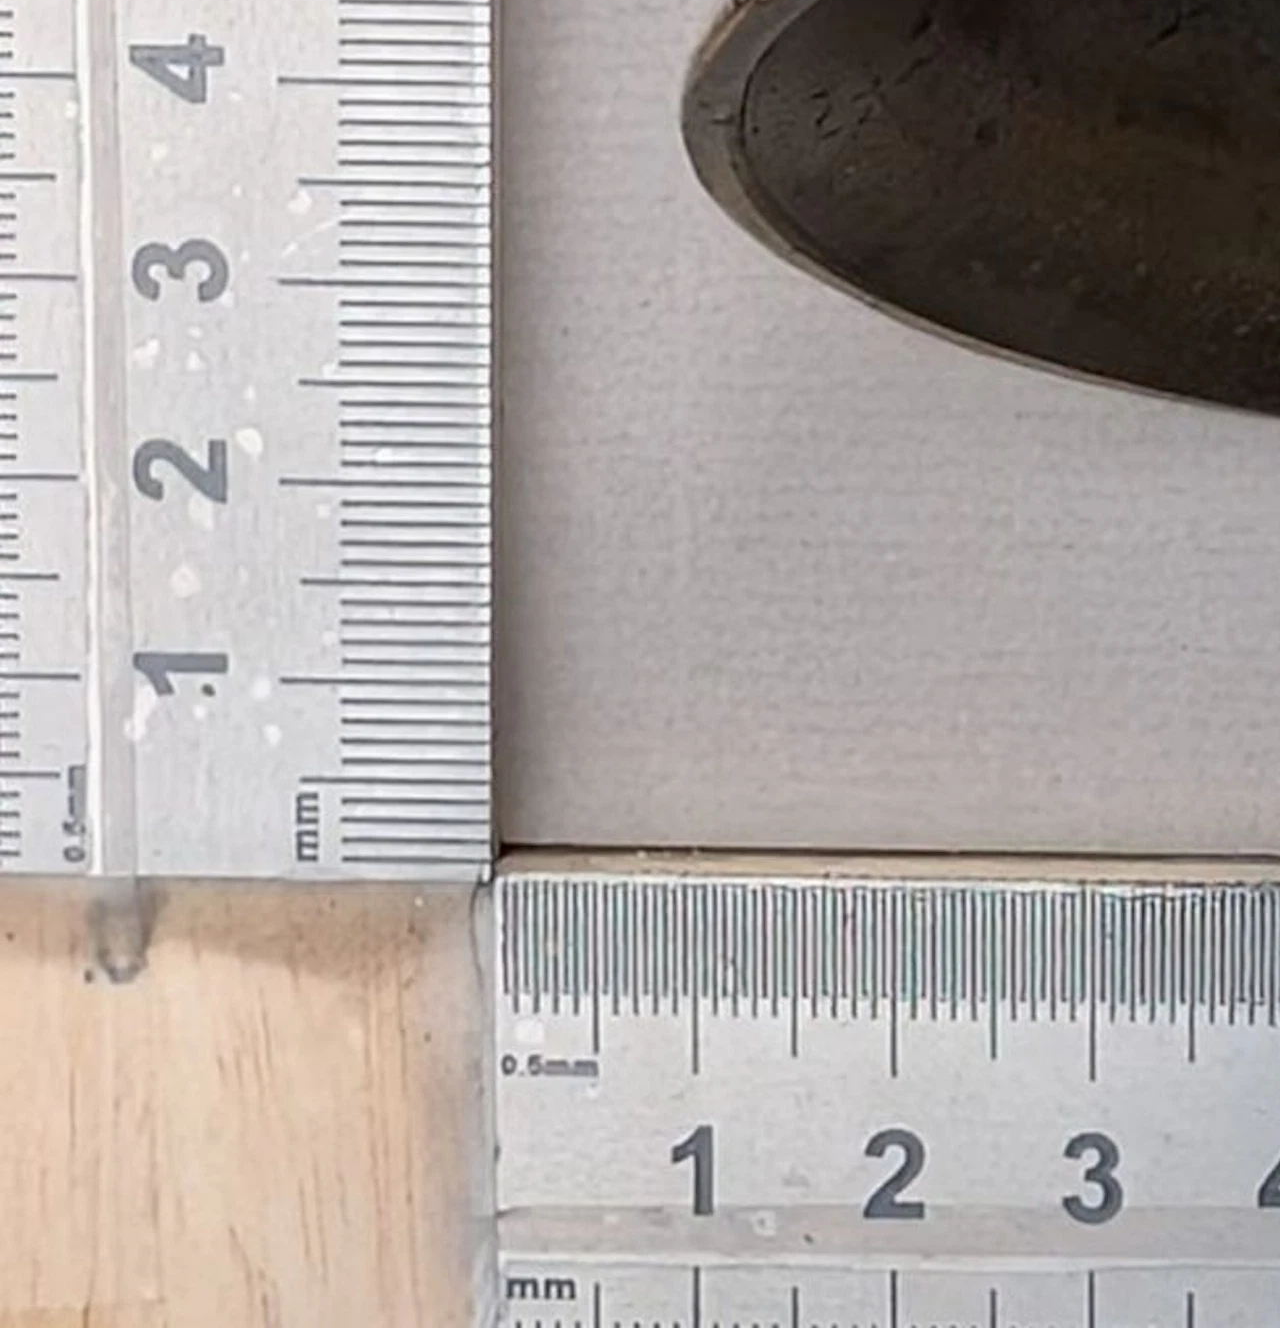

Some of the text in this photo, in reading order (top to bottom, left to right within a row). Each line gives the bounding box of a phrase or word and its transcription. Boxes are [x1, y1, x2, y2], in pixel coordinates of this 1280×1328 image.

[128, 33, 226, 105] 4
[131, 238, 230, 304] 3
[132, 439, 229, 505] 2
[131, 651, 229, 698] 1
[295, 792, 320, 863] mm
[671, 1125, 715, 1217] 1
[862, 1128, 926, 1221] 2
[1061, 1132, 1123, 1226] 3
[506, 1277, 577, 1301] mm
